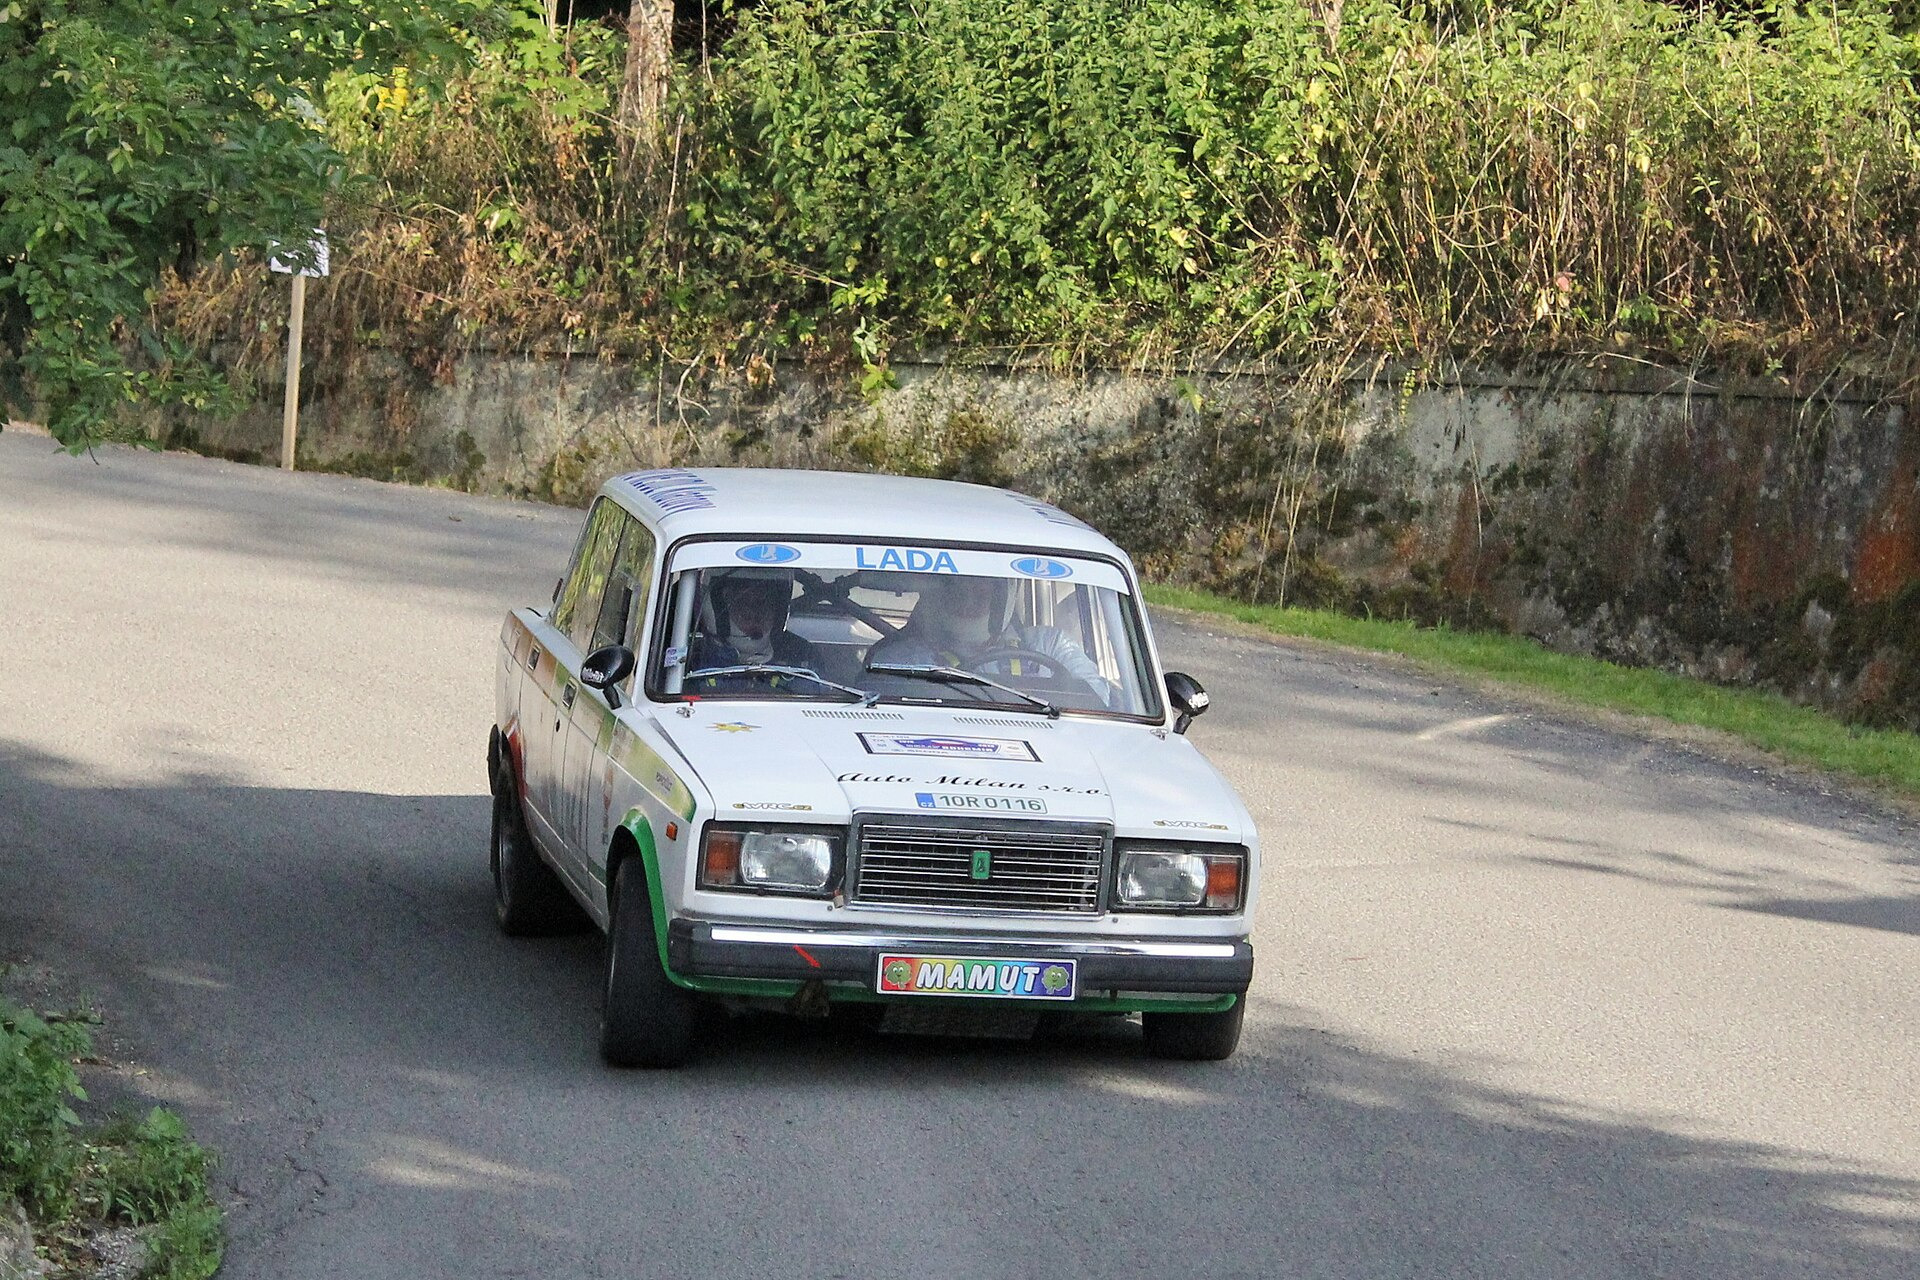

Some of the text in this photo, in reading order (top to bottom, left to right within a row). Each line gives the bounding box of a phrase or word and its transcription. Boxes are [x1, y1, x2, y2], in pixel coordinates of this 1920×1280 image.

[855, 547, 959, 574] LADA
[838, 772, 1110, 796] Auto Milan s.r.o.
[984, 797, 1042, 811] 0116
[916, 962, 1040, 993] MAMUT
